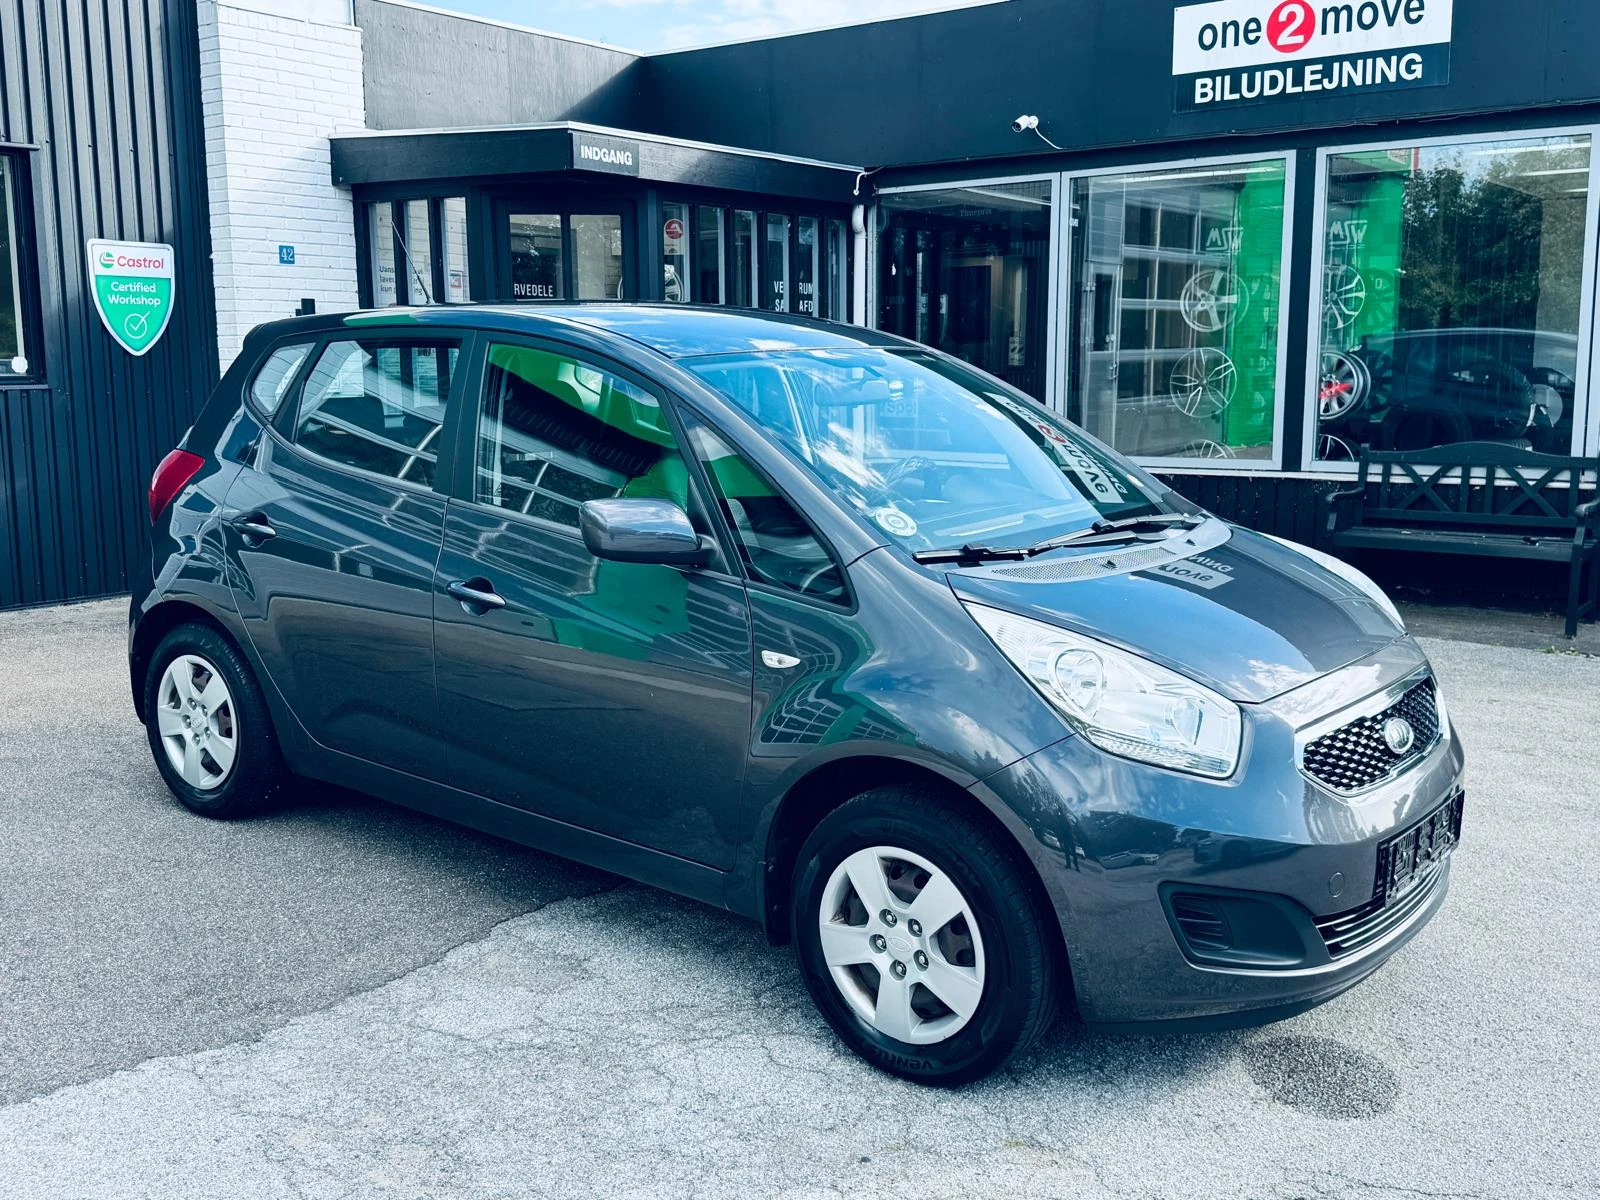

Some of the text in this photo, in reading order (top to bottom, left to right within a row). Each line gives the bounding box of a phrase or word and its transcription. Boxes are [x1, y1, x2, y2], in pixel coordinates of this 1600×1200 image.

[1194, 53, 1423, 104] BILUDLEJNING
[580, 145, 632, 165] INDGANG
[1328, 219, 1368, 245] MSW
[281, 247, 294, 260] 42
[117, 255, 164, 269] Castrol
[110, 281, 157, 293] Certified
[107, 293, 161, 308] Workshop
